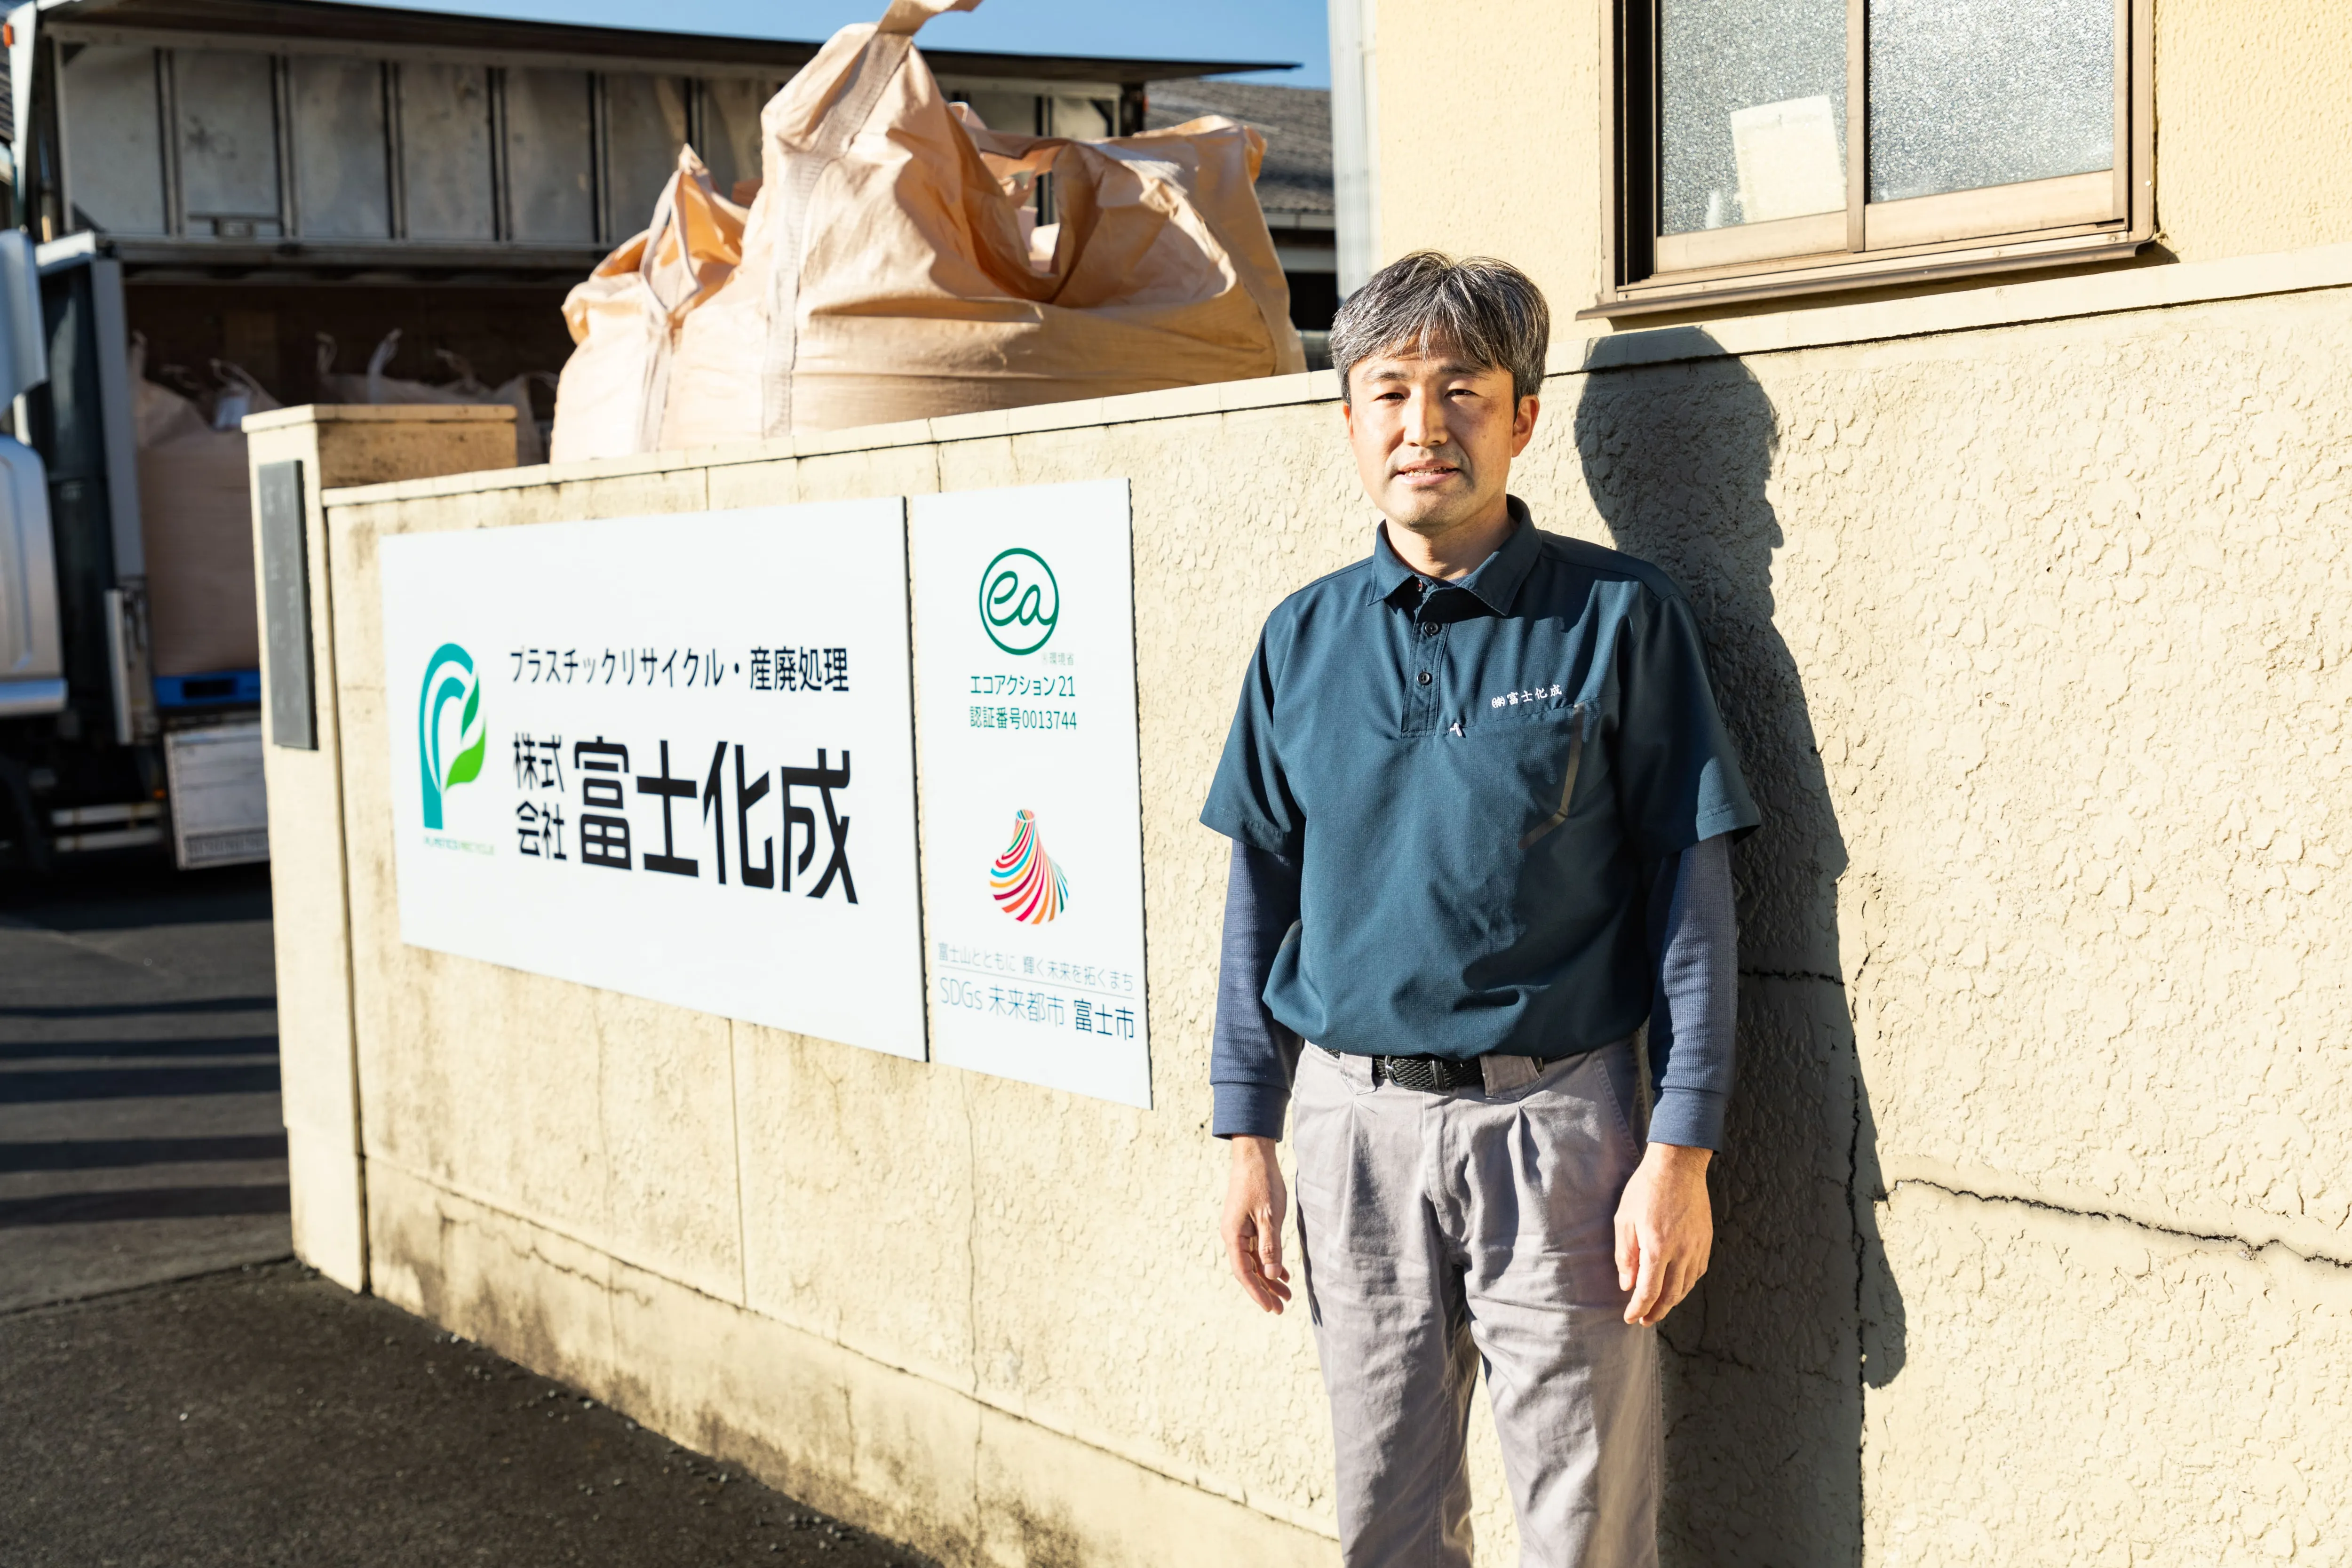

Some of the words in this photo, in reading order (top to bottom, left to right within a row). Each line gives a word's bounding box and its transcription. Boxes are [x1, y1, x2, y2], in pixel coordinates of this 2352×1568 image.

[510, 645, 850, 692] プラスチックリサイクル・産廃処理
[970, 675, 1076, 697] エコアクション21
[969, 706, 1077, 730] 認証番号0013744
[573, 734, 859, 906] 富士化成
[938, 941, 1017, 972] 富士山とともに
[940, 977, 983, 1011] SDGs
[988, 984, 1065, 1027] 未来都市
[1073, 998, 1135, 1041] 富士市
